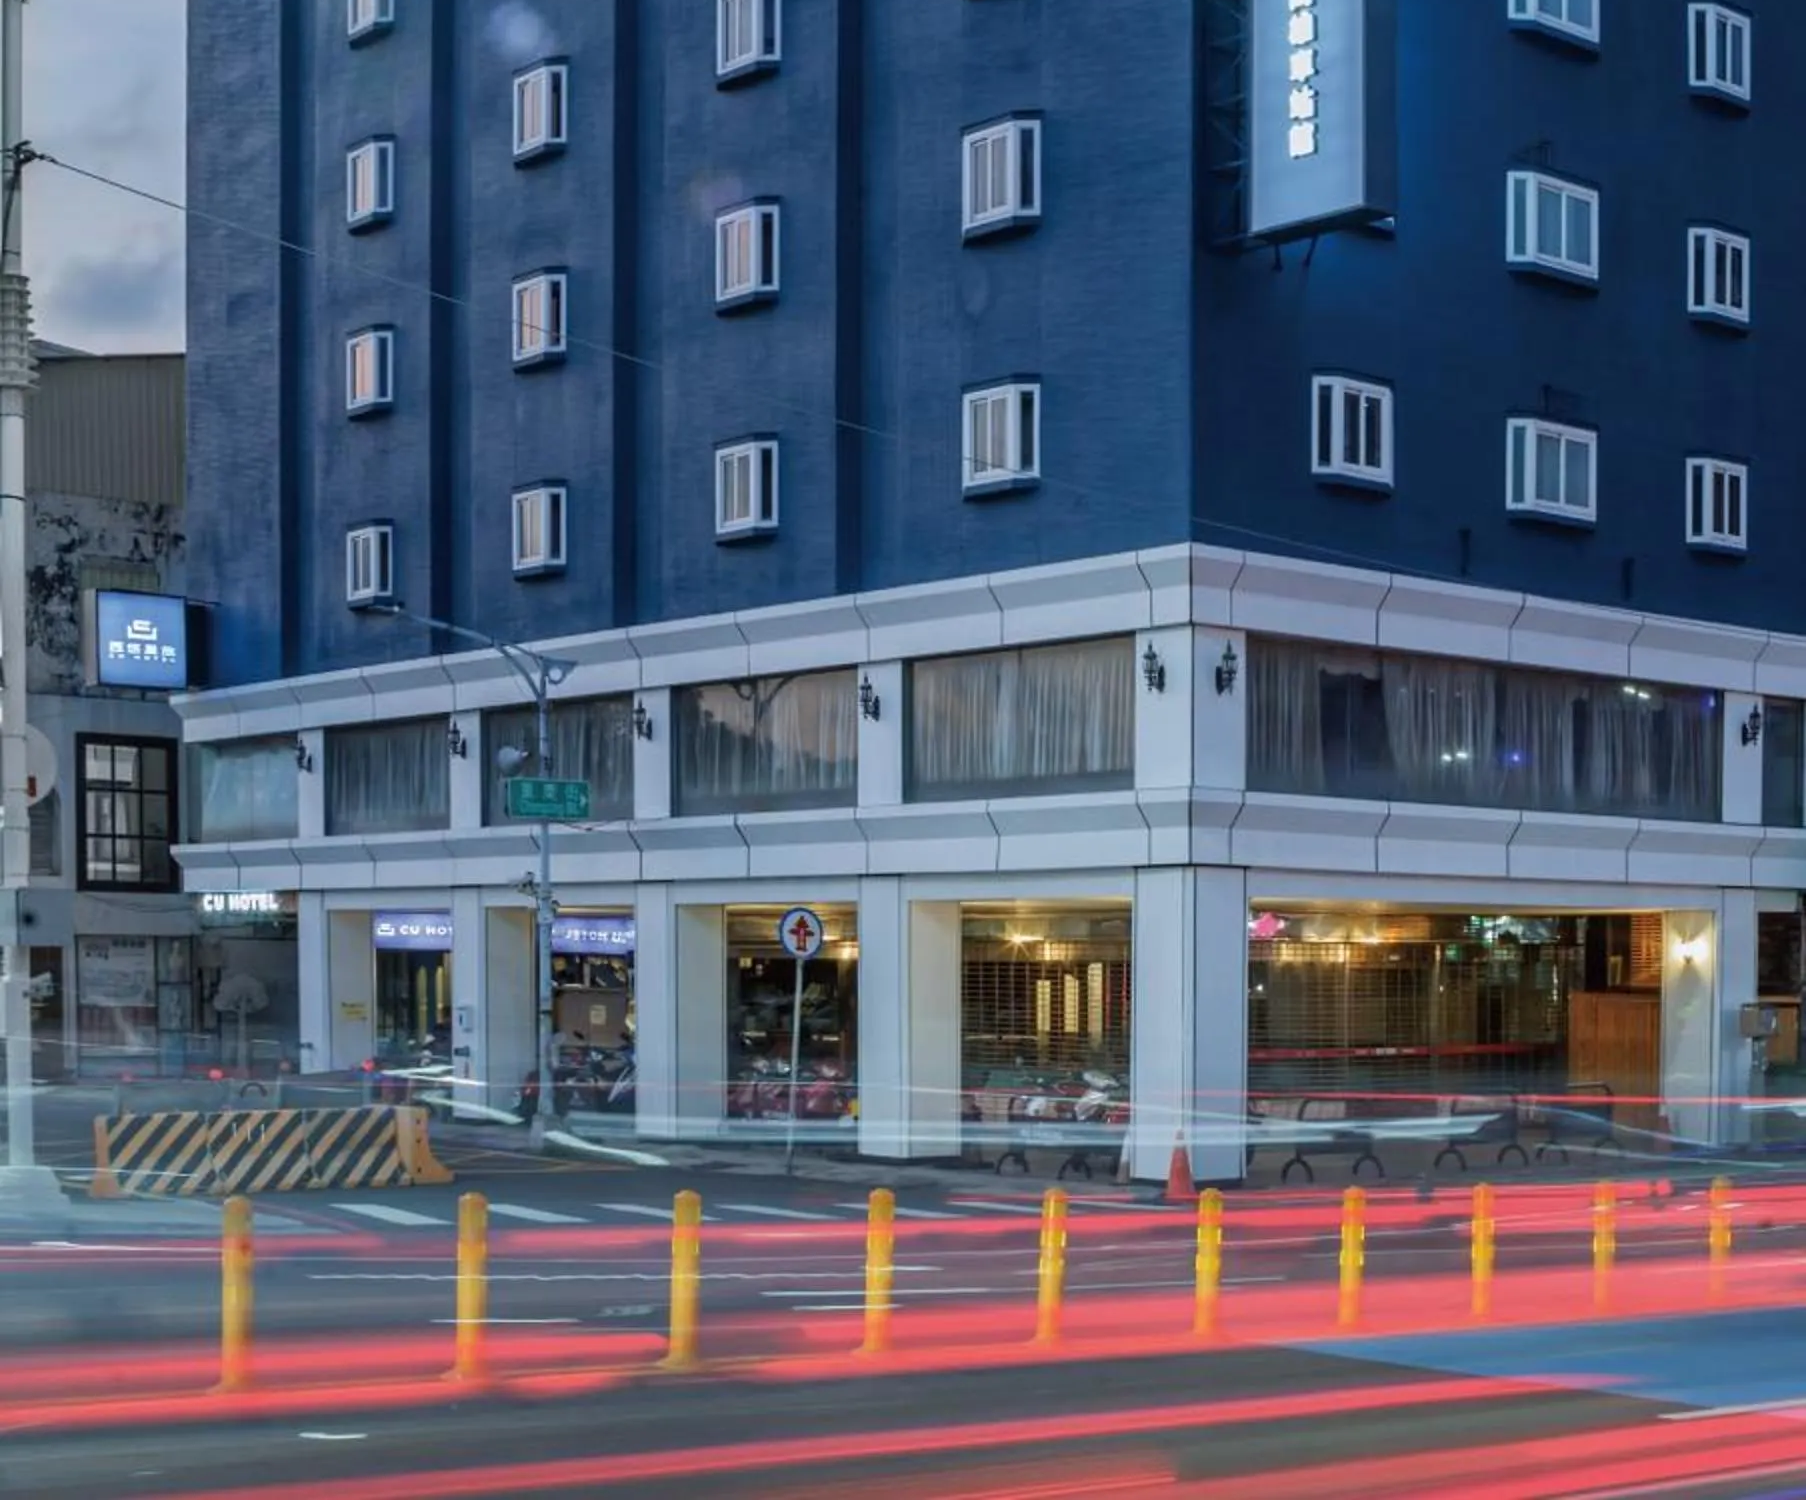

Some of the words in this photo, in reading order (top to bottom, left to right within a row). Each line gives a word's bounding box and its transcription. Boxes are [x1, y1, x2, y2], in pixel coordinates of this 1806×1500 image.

[203, 893, 225, 912] CU
[228, 893, 279, 912] HOTEL
[399, 924, 420, 936] CU
